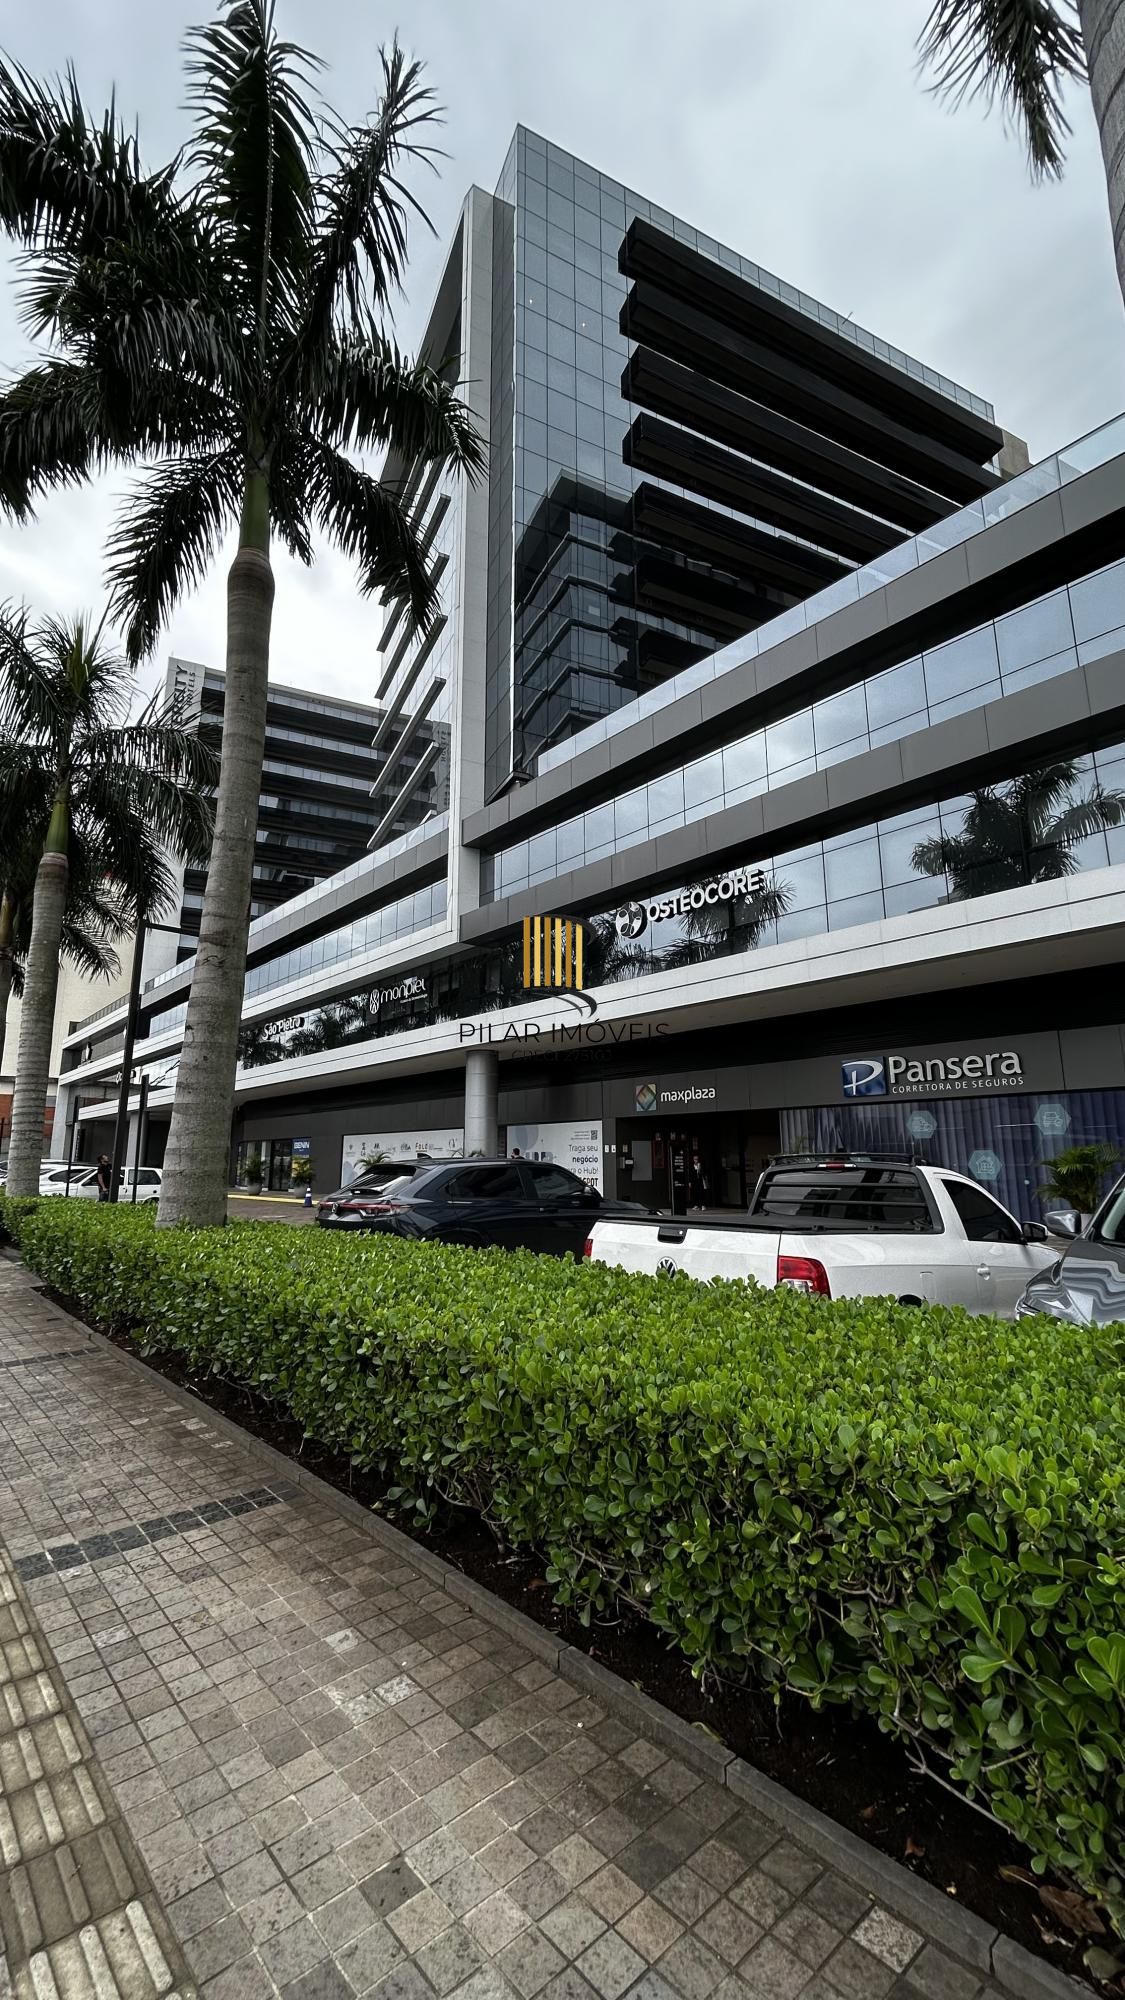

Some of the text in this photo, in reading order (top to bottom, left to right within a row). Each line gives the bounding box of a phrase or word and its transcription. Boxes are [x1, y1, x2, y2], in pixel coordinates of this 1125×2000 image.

[647, 869, 760, 921] OSTEOCORE
[380, 978, 426, 1003] monpiel
[261, 1022, 277, 1040] São
[888, 1051, 1023, 1084] Pansera
[892, 1076, 1025, 1094] CORRETORA DE SEGUROS
[660, 1086, 716, 1104] maxplaza
[569, 1145, 585, 1153] Traga
[572, 1154, 599, 1165] negócio
